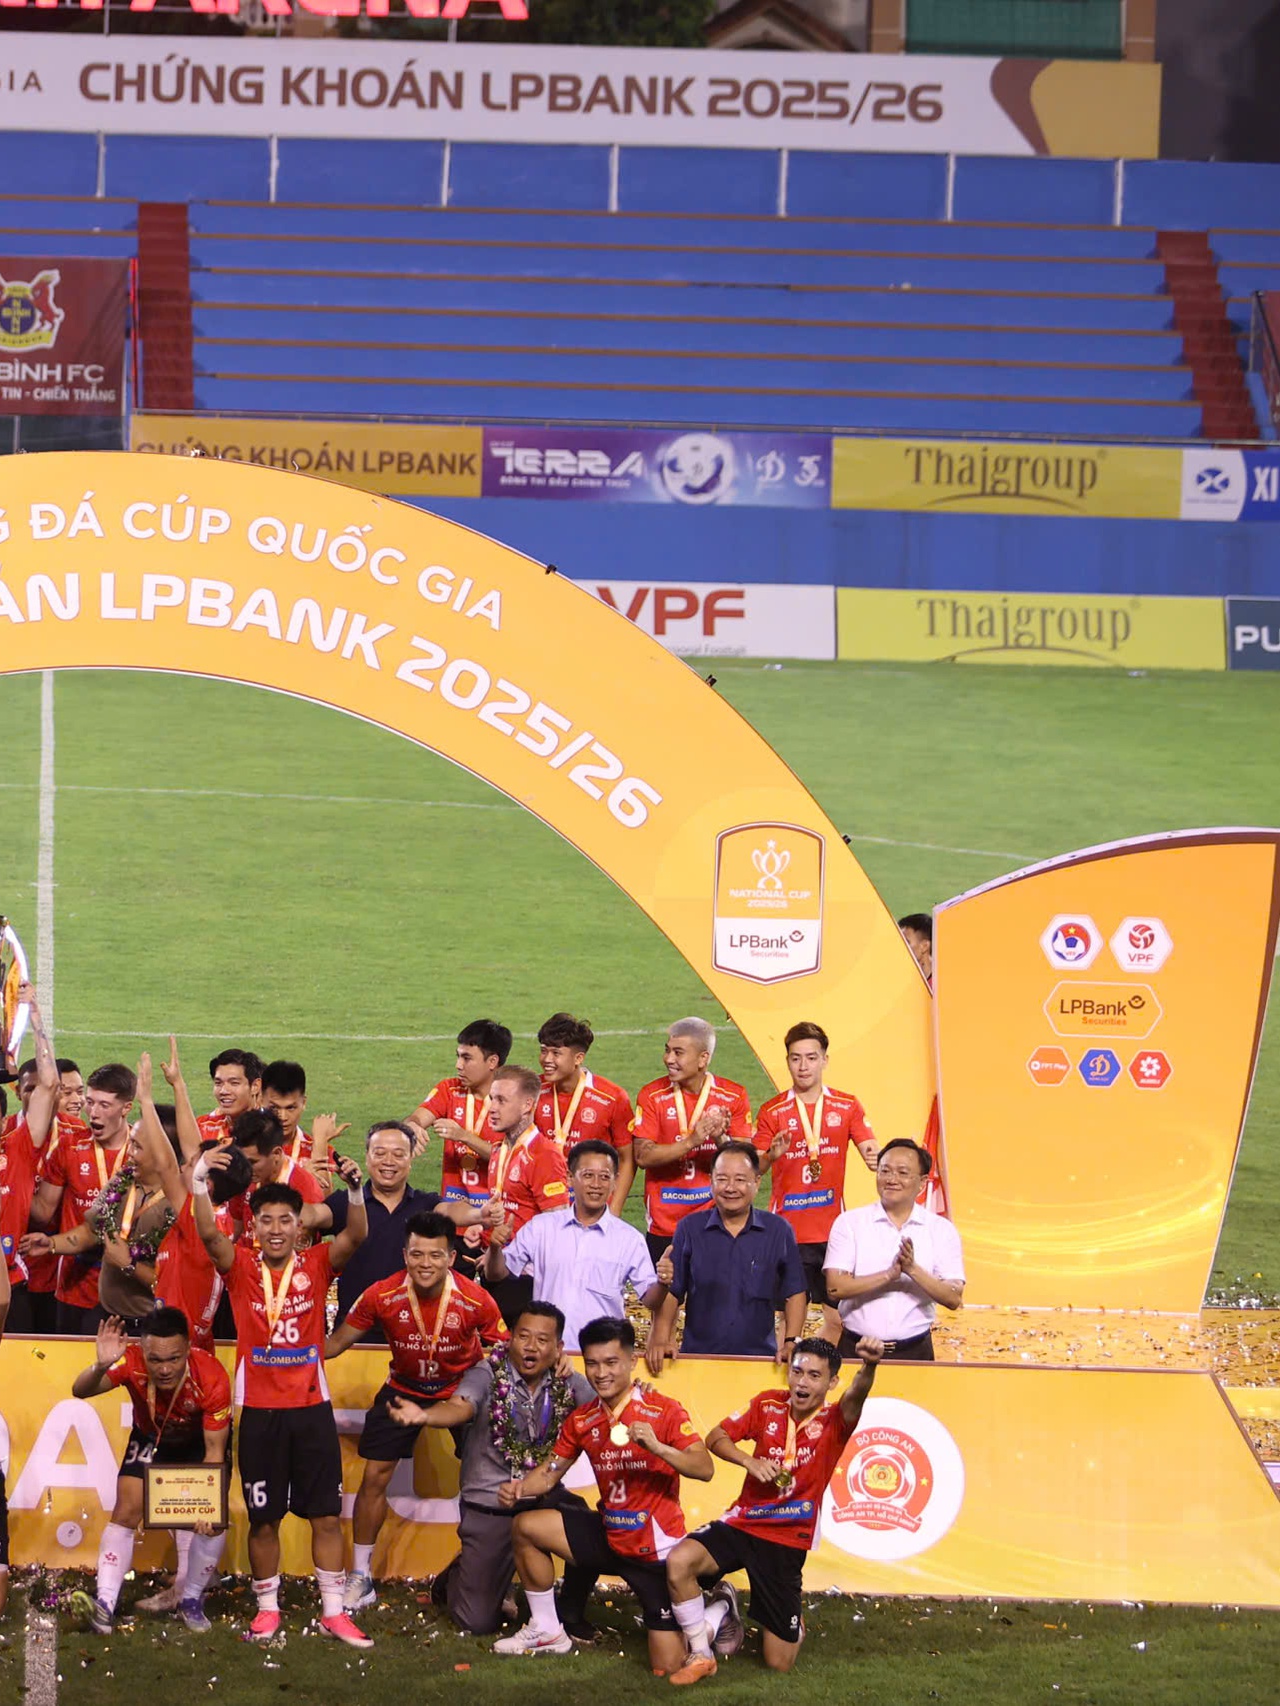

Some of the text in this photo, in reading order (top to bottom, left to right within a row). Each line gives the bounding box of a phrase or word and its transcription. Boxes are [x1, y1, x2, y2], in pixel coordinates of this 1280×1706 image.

[78, 53, 264, 105] CHỨNG
[280, 60, 464, 110] KHOÁN
[481, 72, 696, 117] LPBANK
[706, 79, 944, 127] 2025/26
[67, 365, 105, 383] FC
[2, 387, 23, 399] TIN
[250, 441, 355, 474] KHOÁN
[362, 451, 477, 476] LPBANK
[490, 447, 644, 478] TERRA
[28, 491, 105, 541] ĐÁ
[122, 494, 232, 545] CÚP
[246, 524, 407, 586] QUỐC
[417, 564, 504, 631] GIA
[596, 586, 745, 636] VPF
[100, 571, 396, 671] LPBANK
[395, 635, 664, 830] 2025/26
[729, 934, 789, 949] LPBank
[750, 949, 790, 958] Securities
[1128, 952, 1154, 962] VPF
[1059, 999, 1127, 1016] LPBank
[1081, 1016, 1128, 1026] Securities
[785, 1146, 839, 1160] TP.HỒ MINH
[662, 1191, 711, 1201] SACOMBANK
[784, 1195, 828, 1207] SACOMBANK
[292, 1294, 305, 1304] AN
[271, 1317, 300, 1344] 26
[253, 1354, 308, 1365] SACOMBANK
[417, 1358, 440, 1378] 12
[856, 1430, 916, 1454] BỘ CÔNG AN
[620, 1449, 632, 1459] AN
[797, 1446, 811, 1455] AN
[173, 1506, 197, 1516] ĐOẠT
[198, 1505, 216, 1514] CÚP
[605, 1514, 637, 1526] OMBANK
